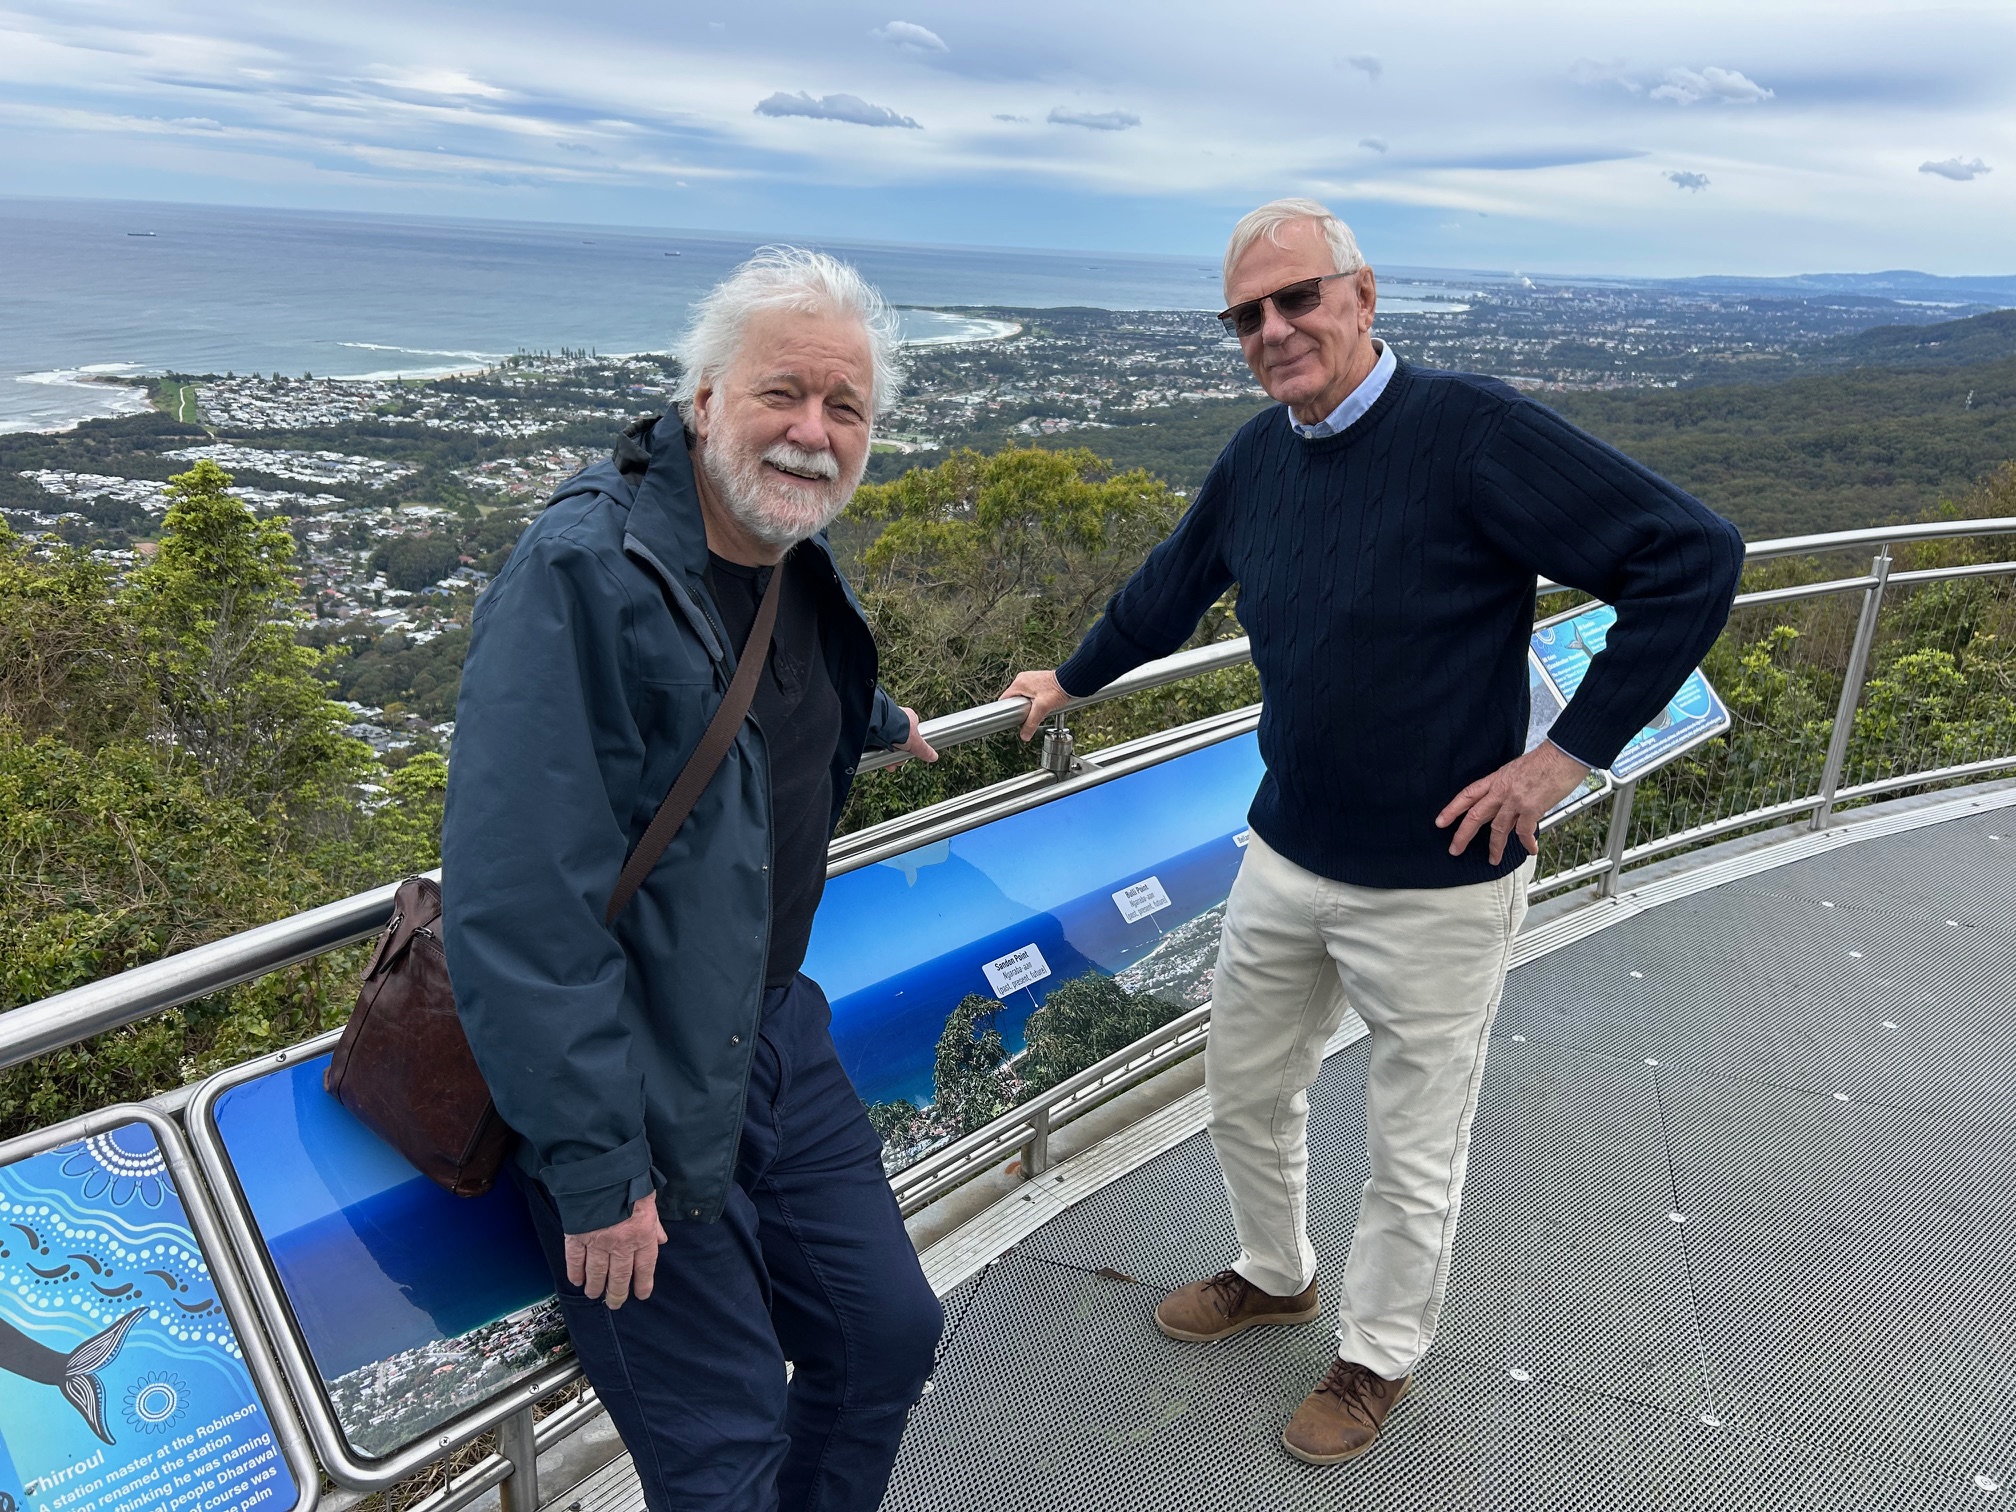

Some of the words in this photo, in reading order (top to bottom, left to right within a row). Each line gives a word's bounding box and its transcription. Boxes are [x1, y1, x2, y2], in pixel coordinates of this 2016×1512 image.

[995, 958, 1016, 971] Sandon
[1013, 951, 1030, 963] Point
[997, 983, 1012, 995] (past,
[1011, 974, 1032, 990] present,
[1029, 965, 1048, 979] future)
[24, 1448, 105, 1496] Thirroul
[39, 1503, 51, 1512] A
[52, 1478, 104, 1509] station
[105, 1453, 153, 1483] master
[156, 1444, 171, 1459] at
[171, 1434, 195, 1451] the
[195, 1403, 258, 1439] Robinson
[98, 1467, 160, 1507] renamed
[161, 1458, 185, 1475] the
[186, 1434, 232, 1463] station
[114, 1483, 173, 1512] thinking
[173, 1473, 192, 1488] he
[193, 1459, 221, 1477] was
[222, 1432, 271, 1463] naming
[169, 1480, 216, 1511] people
[216, 1445, 278, 1485] Dharawal
[204, 1480, 250, 1510] course
[250, 1466, 278, 1486] was
[240, 1487, 273, 1512] palm
